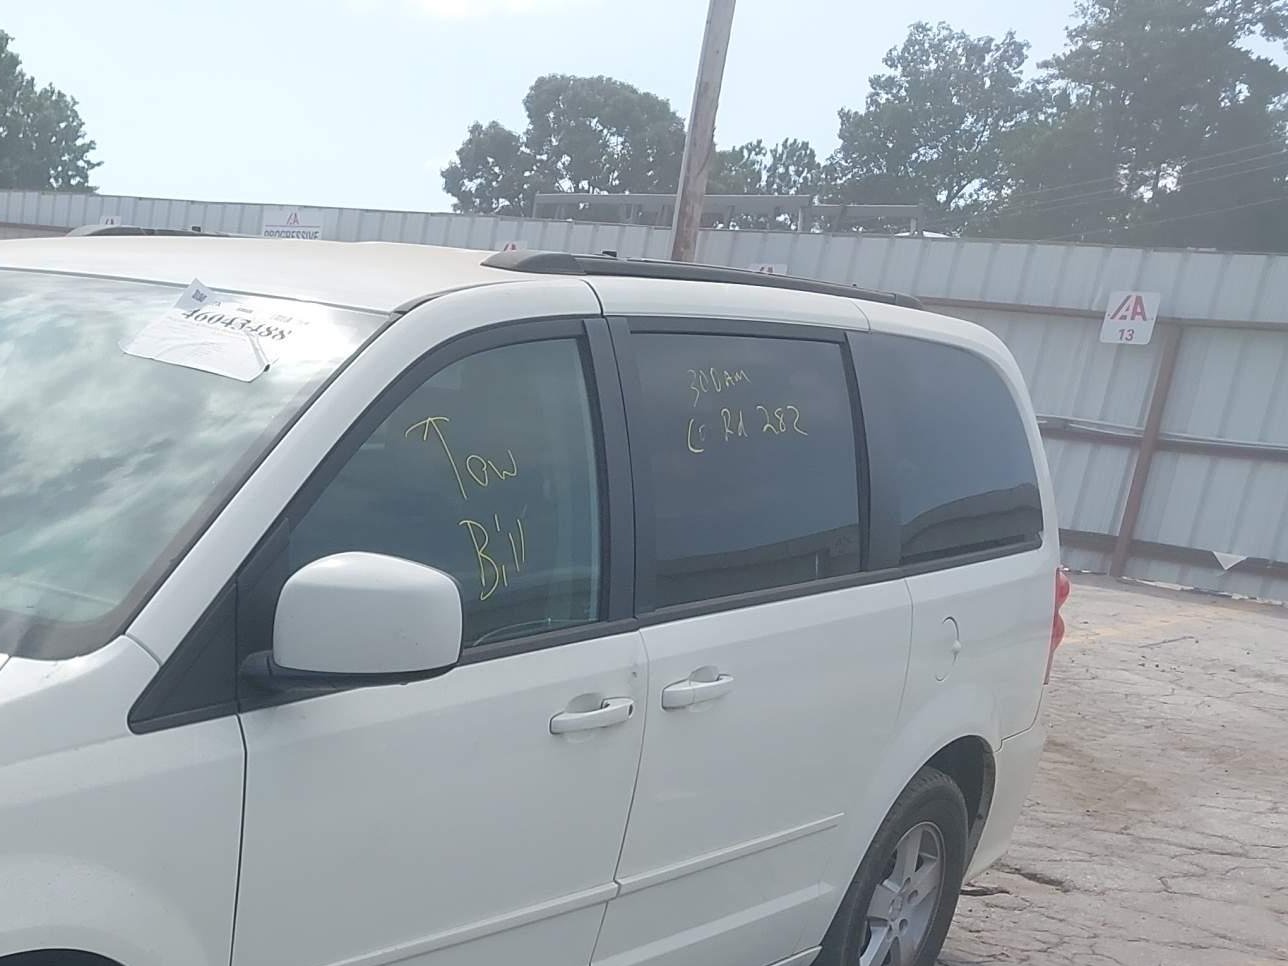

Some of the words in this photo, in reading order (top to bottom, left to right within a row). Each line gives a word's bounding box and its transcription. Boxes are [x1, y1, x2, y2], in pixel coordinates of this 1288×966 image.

[1118, 328, 1135, 342] 13
[756, 404, 809, 435] 282
[405, 416, 518, 500] Tow
[458, 512, 527, 601] Bill
